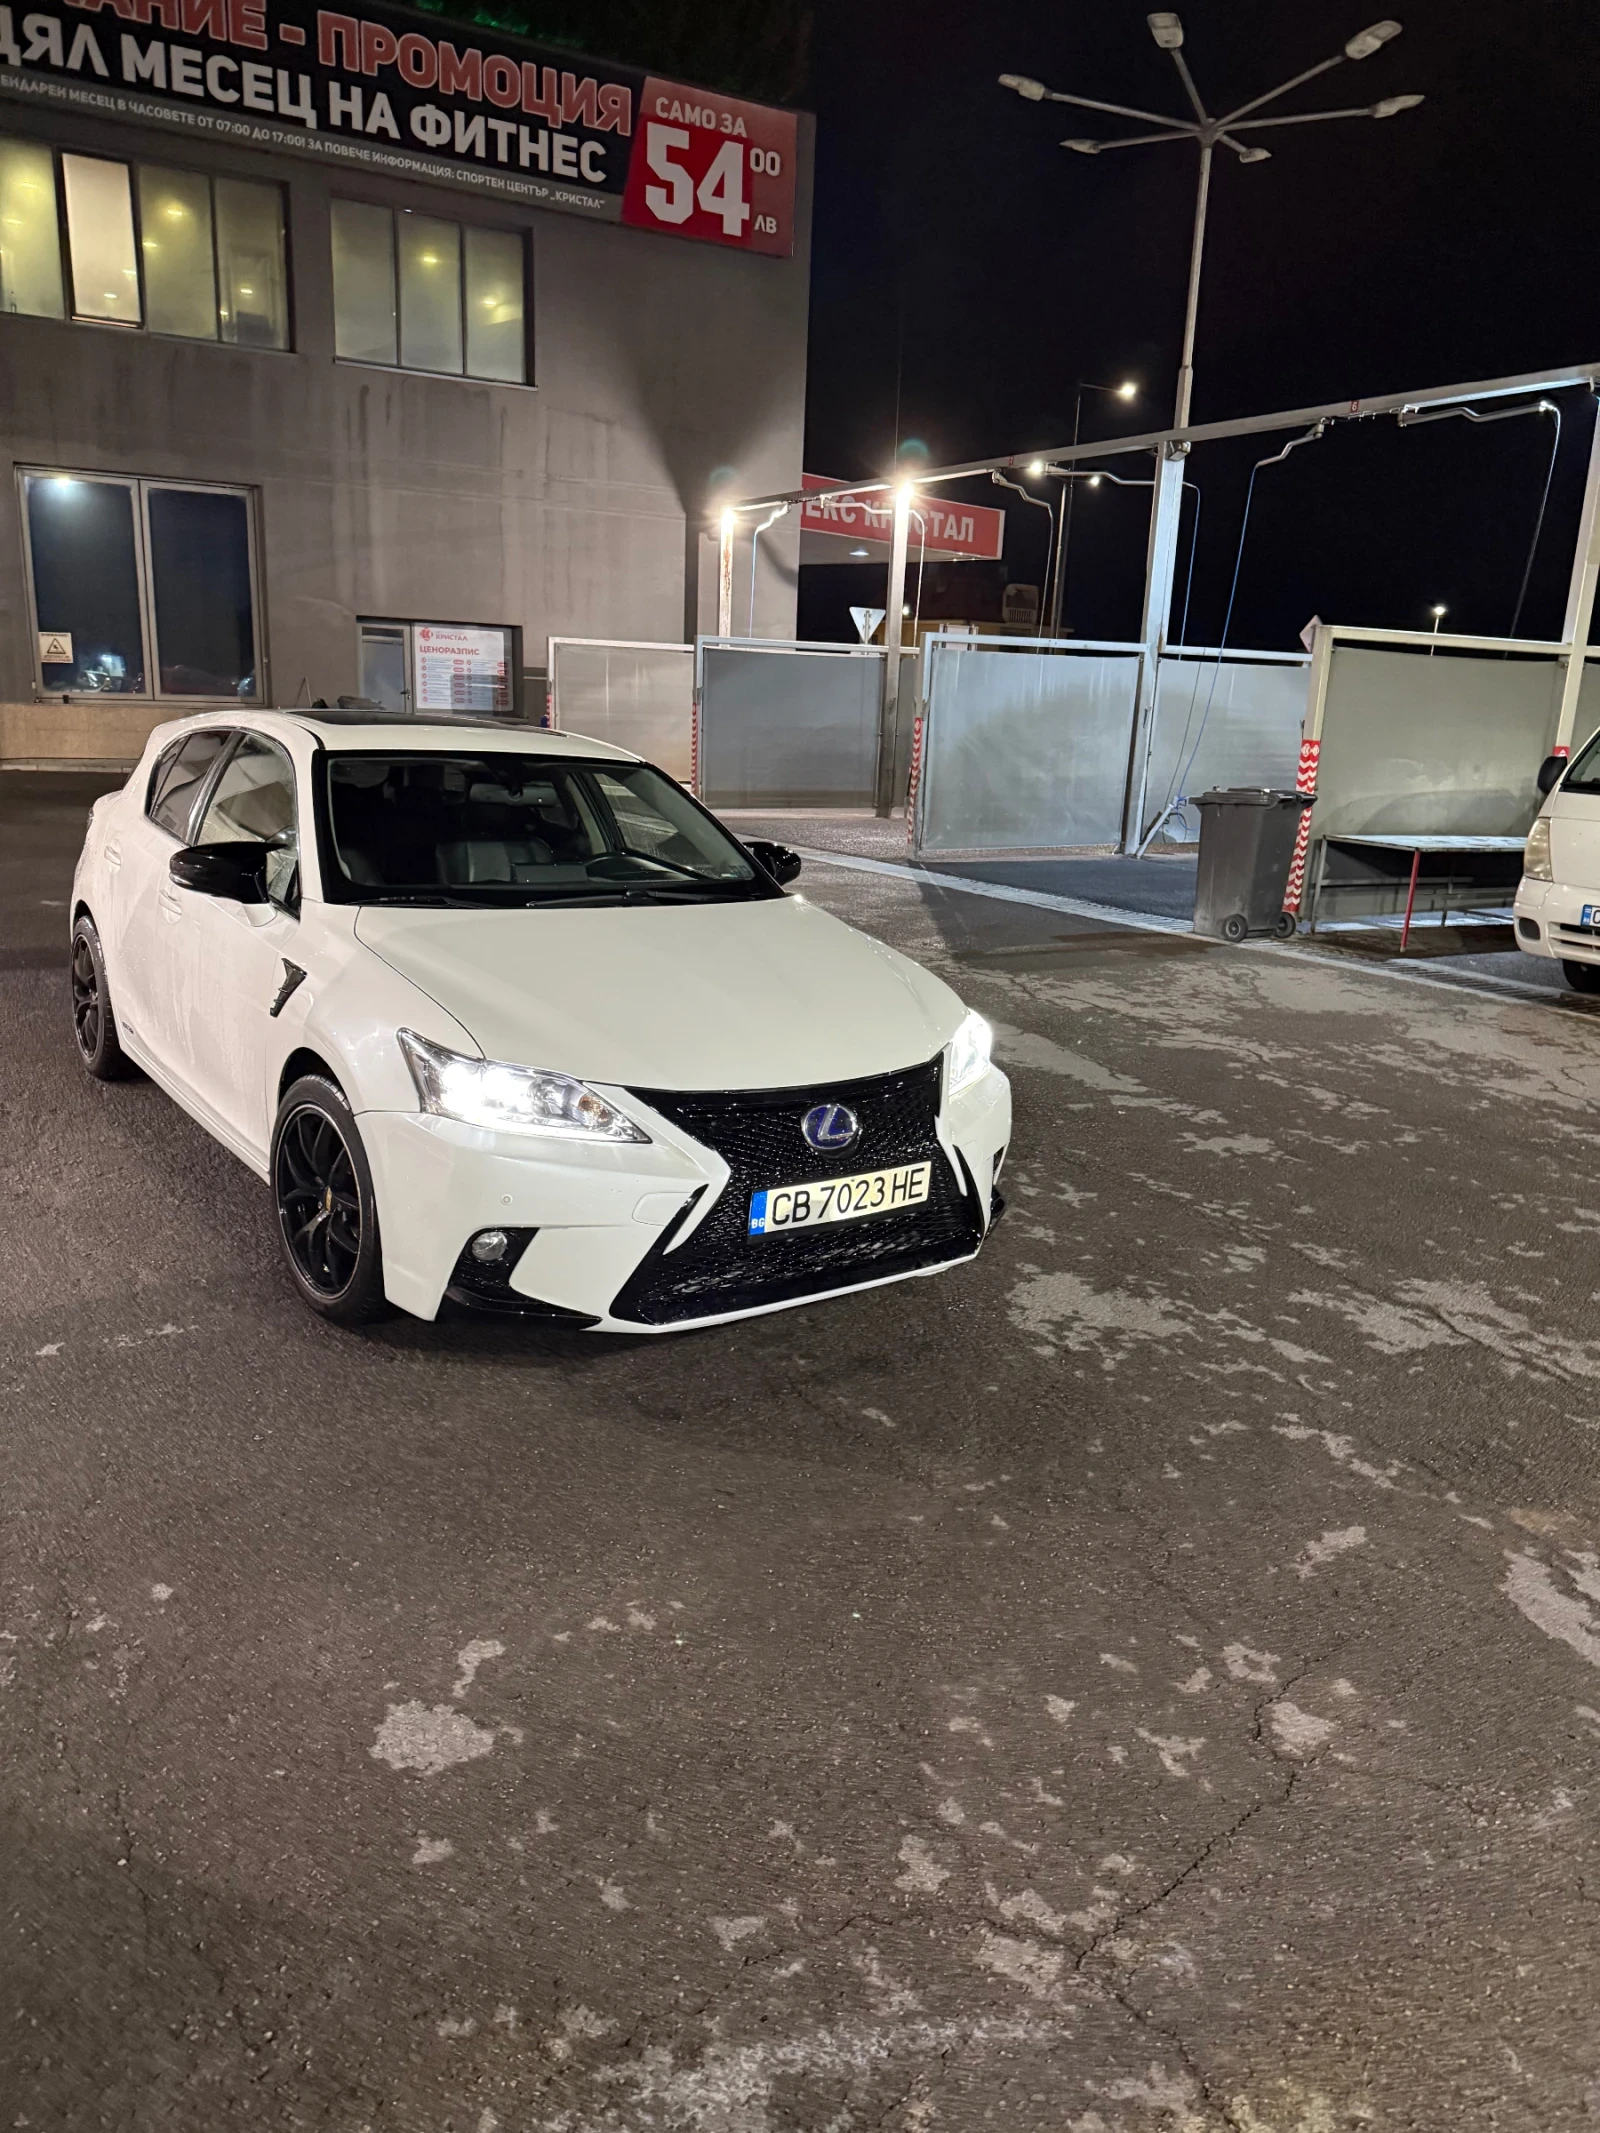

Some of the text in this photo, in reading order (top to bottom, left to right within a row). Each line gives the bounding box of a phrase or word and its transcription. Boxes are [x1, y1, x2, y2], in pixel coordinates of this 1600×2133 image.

[317, 9, 632, 137] ПРОМОЦИЯ
[121, 33, 317, 129] МЕСЕЦ
[328, 80, 401, 140] НА
[409, 103, 607, 184] ФИТНЕС
[655, 96, 748, 139] САМО ЗА
[69, 88, 115, 112] МЕСЕЦ
[117, 99, 126, 111] В
[128, 101, 195, 126] ЧАСОВЕТЕ
[197, 115, 215, 129] ОТ
[216, 119, 250, 137] 07:00
[252, 126, 270, 142] ДО
[308, 137, 323, 151] ЗА
[324, 140, 371, 162] ПОВЕЧЕ
[372, 150, 455, 180] ИНФОРМАЦИЯ:
[456, 169, 505, 188] СПОРТЕН
[506, 178, 549, 198] ЦЕНТЪР
[645, 121, 781, 237] 54 00
[754, 214, 777, 234] ЛВ
[800, 495, 974, 543] ЕКС КСТАЛ
[419, 645, 480, 656] ЦЕНОРАЗПИС
[751, 1216, 765, 1229] BG
[771, 1167, 926, 1226] CB 7023 HE
